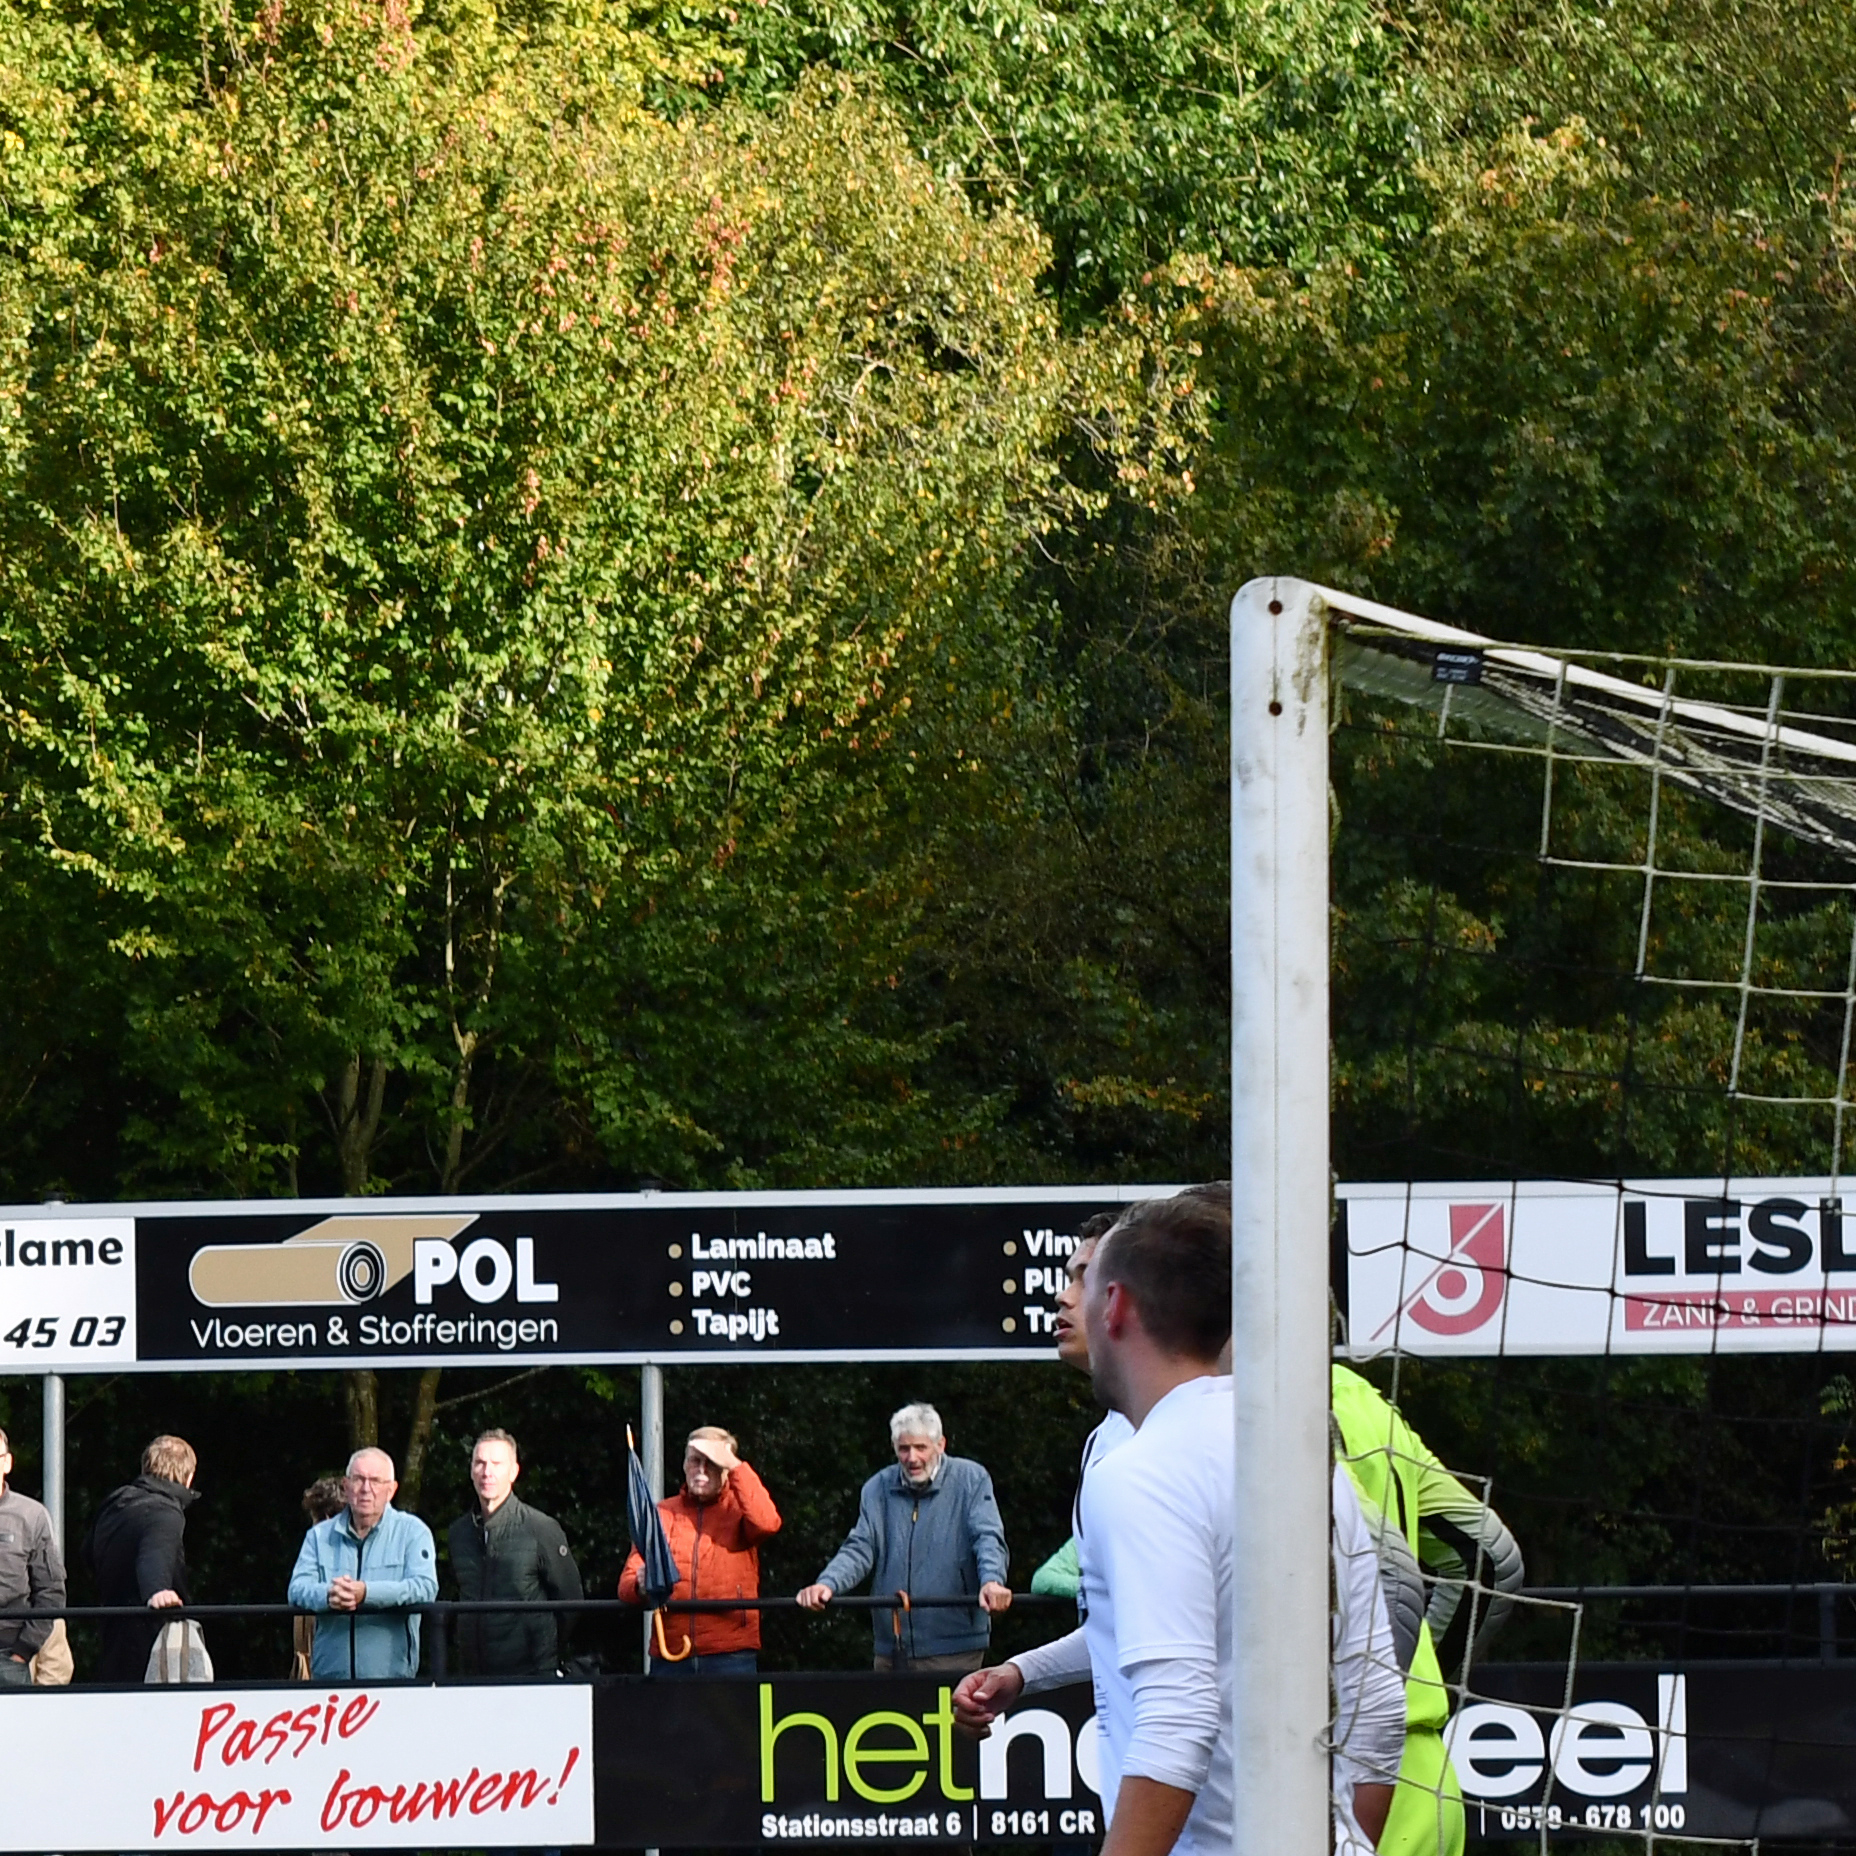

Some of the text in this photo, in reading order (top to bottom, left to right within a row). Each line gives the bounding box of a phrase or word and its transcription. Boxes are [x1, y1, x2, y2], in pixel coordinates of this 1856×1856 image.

[691, 1232, 837, 1260] Laminaat
[413, 1236, 560, 1305] POL
[691, 1270, 752, 1298] PVC
[691, 1307, 780, 1341] Tapijt
[1642, 1298, 1730, 1327] ZAND
[1740, 1297, 1762, 1326] &
[2, 1316, 61, 1350] 45
[68, 1315, 128, 1348] 03
[190, 1313, 559, 1350] Vloeren & Stofferingen
[192, 1693, 381, 1773] Passie
[151, 1746, 581, 1839] voor bouwen!
[761, 1809, 1096, 1839] Stationsstraat 6 8161 CR
[1585, 1803, 1632, 1829] 678
[1640, 1803, 1686, 1830] 100
